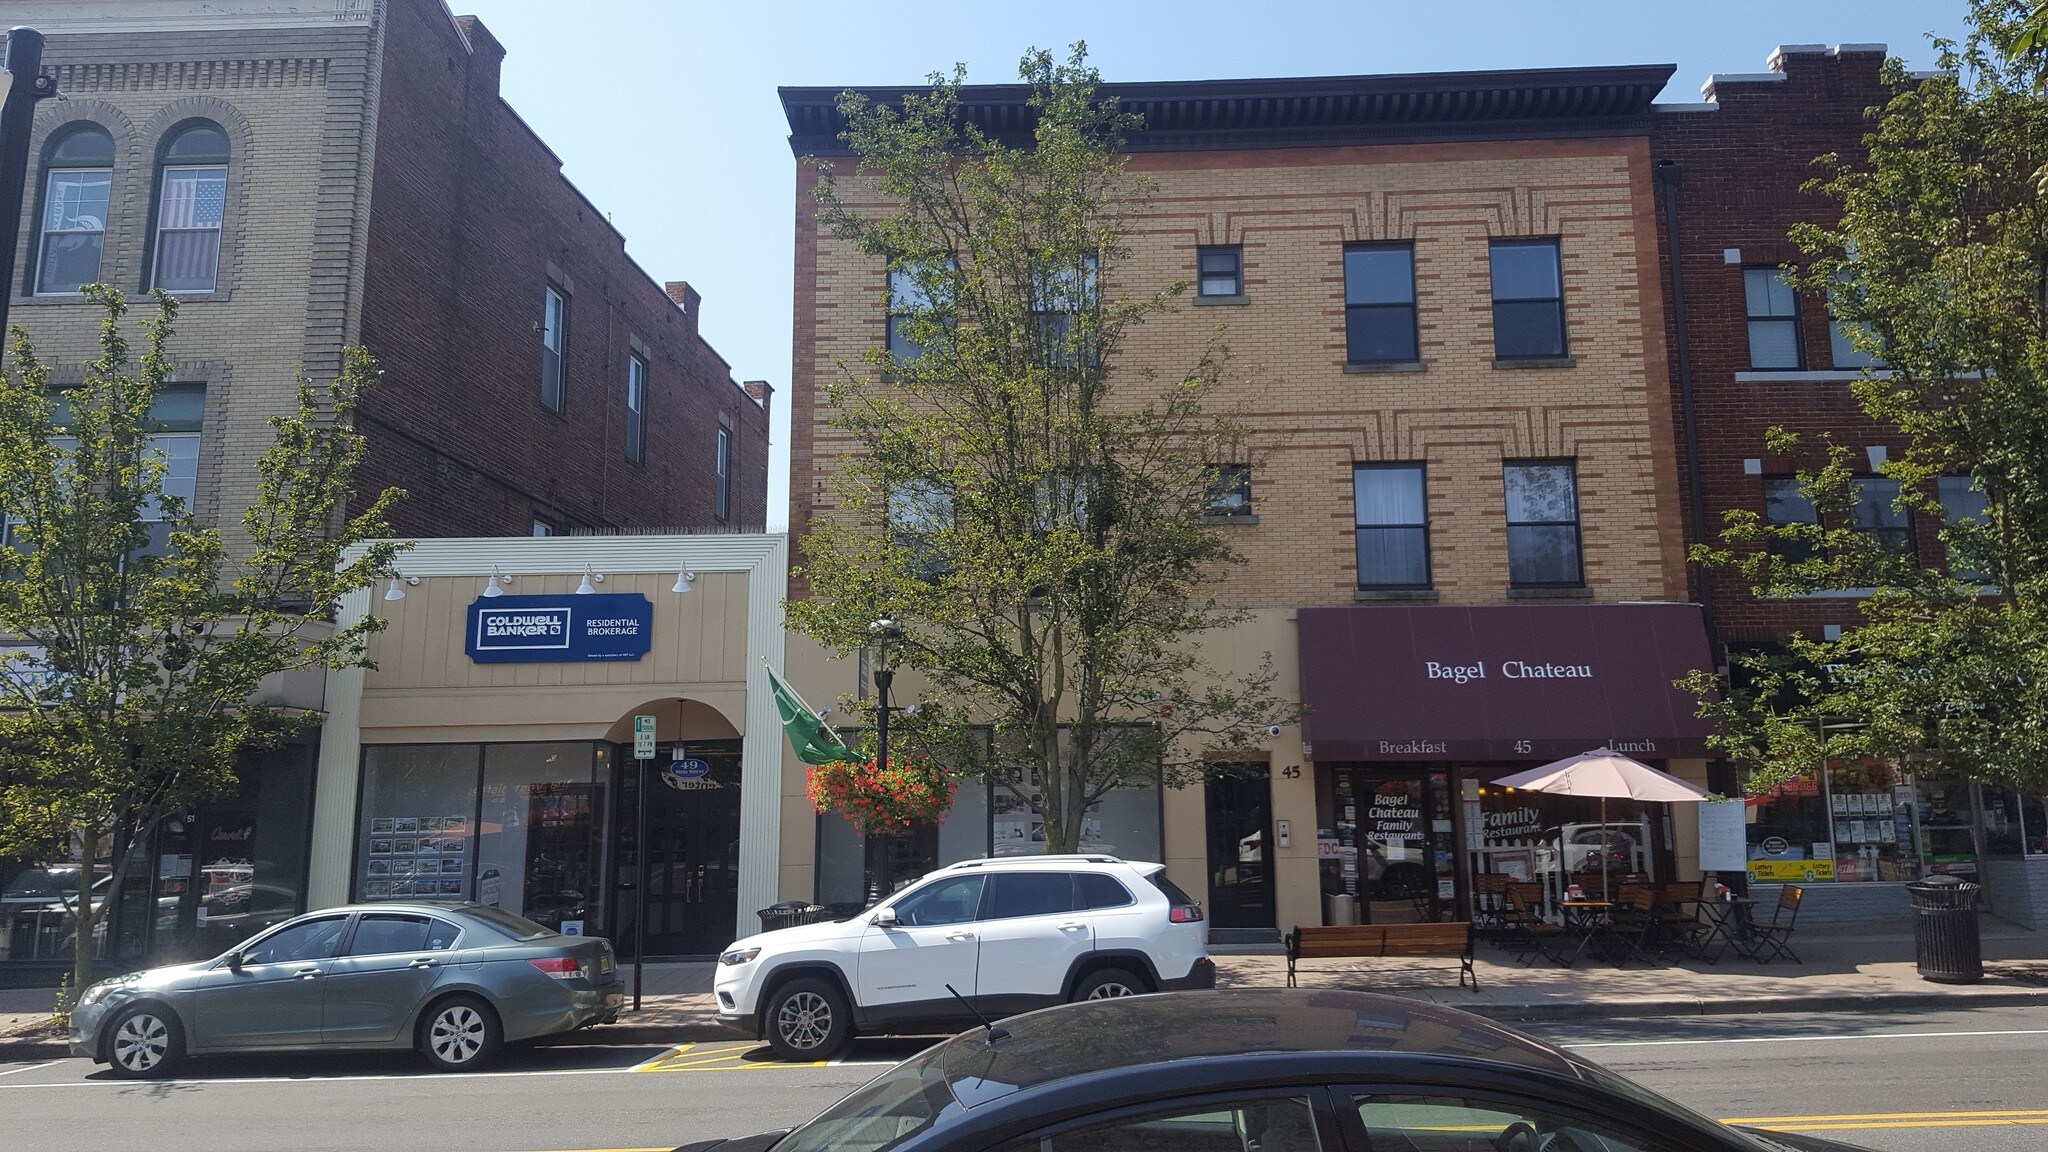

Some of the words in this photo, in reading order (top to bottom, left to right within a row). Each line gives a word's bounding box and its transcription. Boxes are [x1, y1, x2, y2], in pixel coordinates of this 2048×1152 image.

[487, 615, 562, 625] COLDWELL
[586, 618, 640, 627] RESIDENTIAL
[487, 625, 547, 637] BANKER
[587, 627, 638, 636] BROKERAGE
[1425, 661, 1487, 684] Bagel
[1502, 661, 1593, 679] Chateau
[1379, 740, 1447, 754] Breakfast
[1513, 740, 1531, 754] 45
[1609, 739, 1656, 752] Lunch
[680, 760, 698, 770] 49
[1282, 765, 1300, 779] 45
[1374, 794, 1408, 807] Bagel
[187, 814, 195, 823] 51
[1368, 807, 1419, 819] Chateau
[1482, 807, 1539, 826] Family
[1376, 820, 1413, 832] Family
[1483, 823, 1542, 839] Restaurant
[1368, 831, 1423, 840] Restaurant
